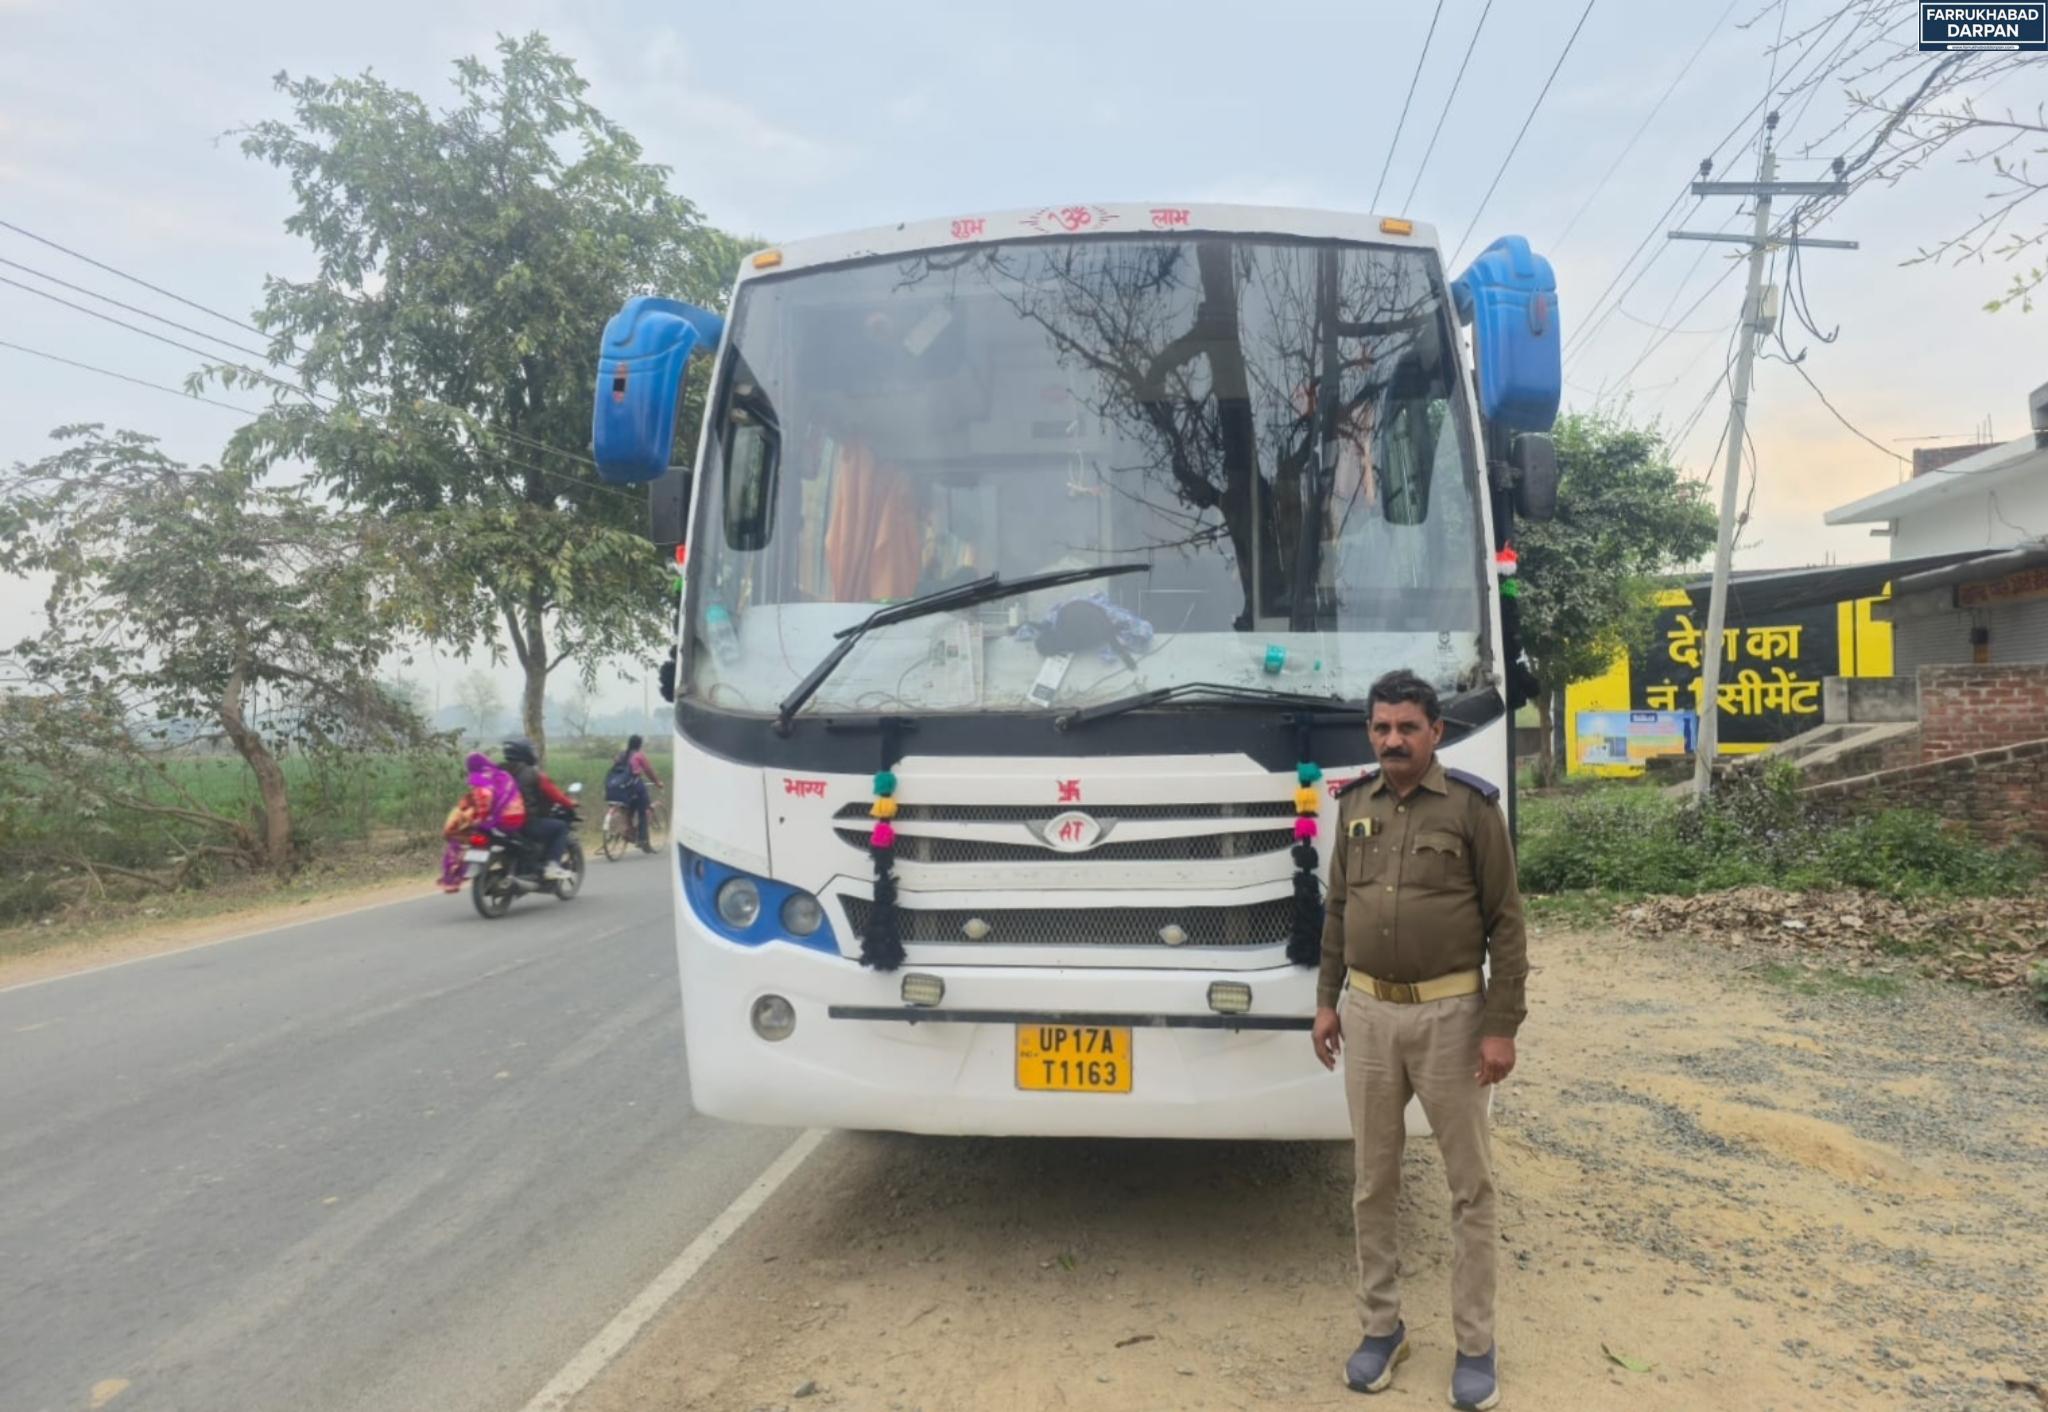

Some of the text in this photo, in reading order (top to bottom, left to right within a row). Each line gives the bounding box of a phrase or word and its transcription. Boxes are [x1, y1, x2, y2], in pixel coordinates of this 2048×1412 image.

[951, 218, 986, 239] शुभ
[1149, 208, 1191, 229] लाभ
[1746, 624, 1802, 661] का
[1717, 666, 1821, 716] सीमेंट
[783, 777, 827, 800] भाग्य
[1059, 821, 1085, 843] AT
[1042, 1059, 1117, 1086] T1163
